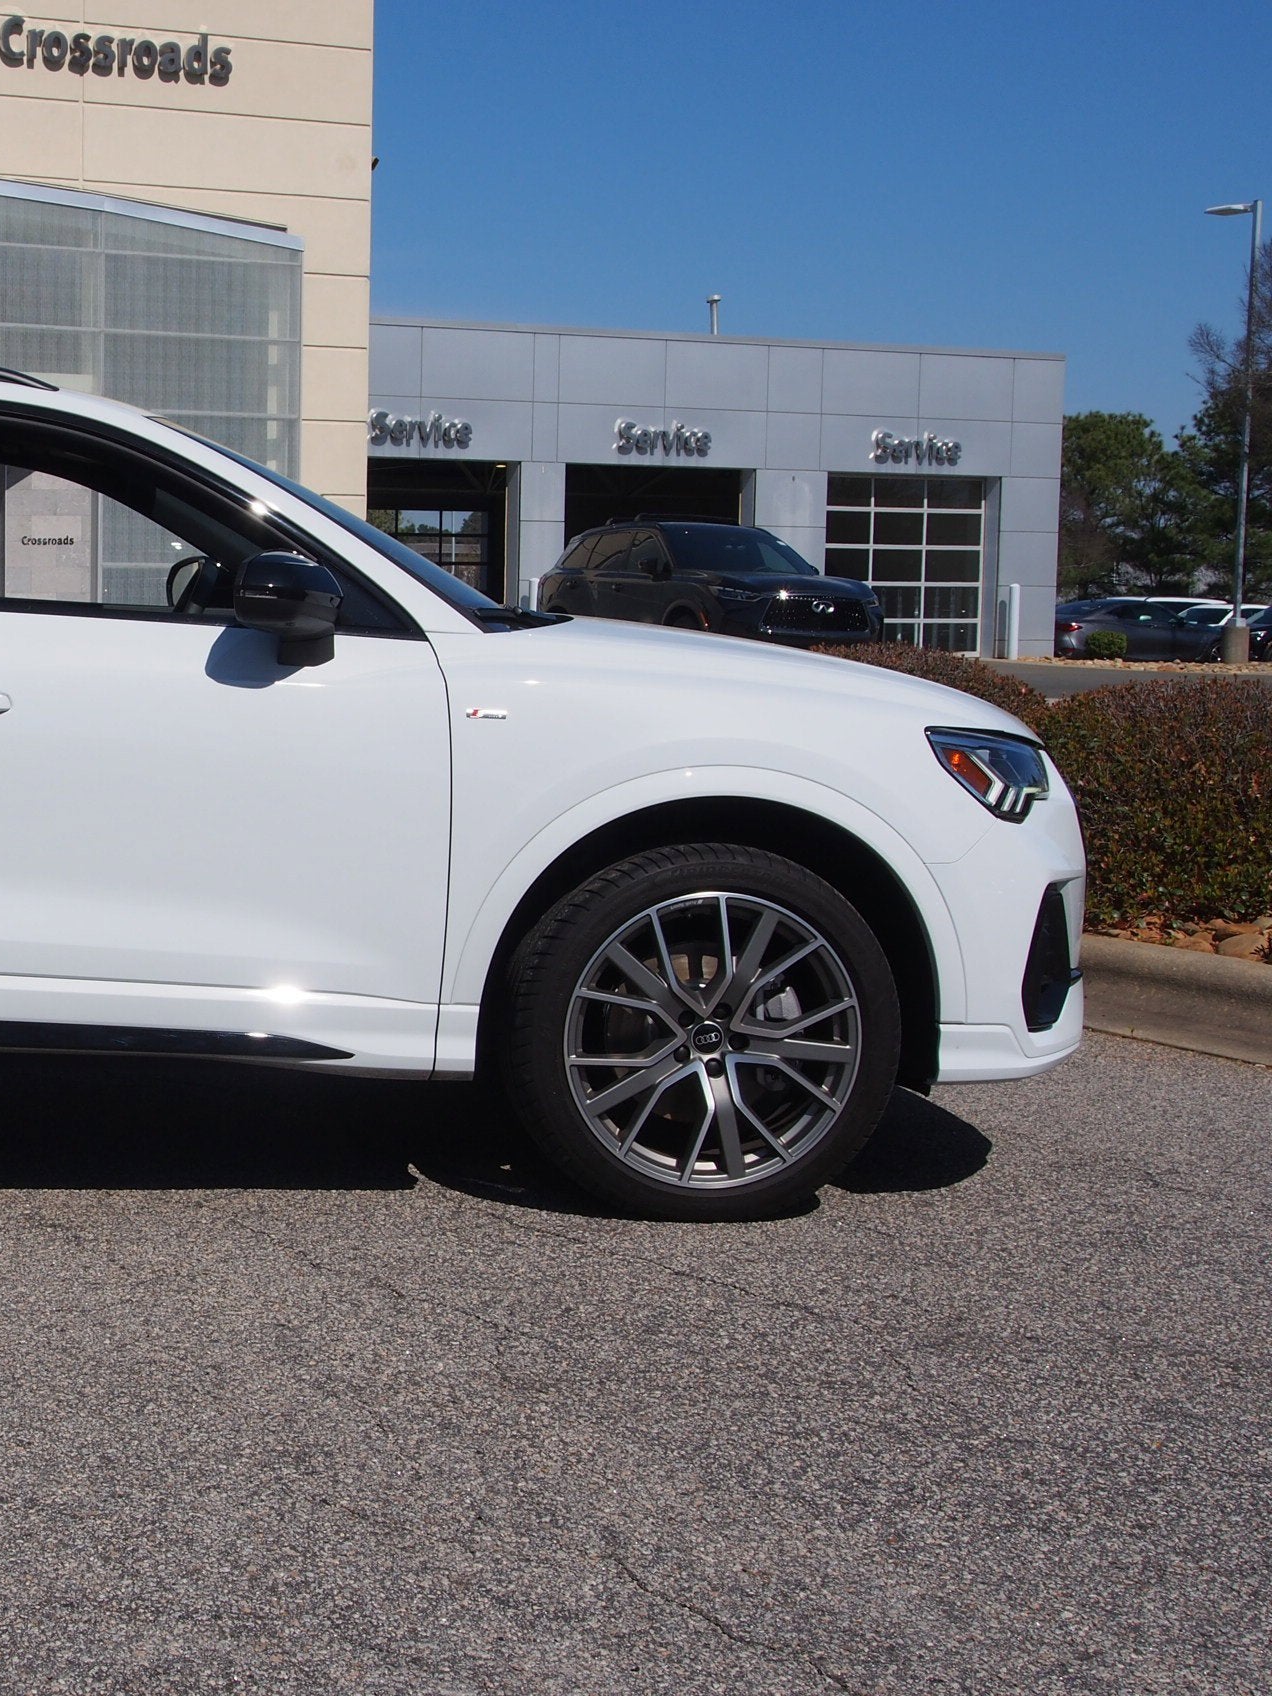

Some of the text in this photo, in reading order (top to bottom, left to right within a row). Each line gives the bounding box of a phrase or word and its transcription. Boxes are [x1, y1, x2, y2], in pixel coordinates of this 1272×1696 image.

[369, 409, 473, 448] Service
[615, 419, 712, 457] Service
[872, 430, 962, 466] Service
[21, 534, 75, 546] Crossroads
